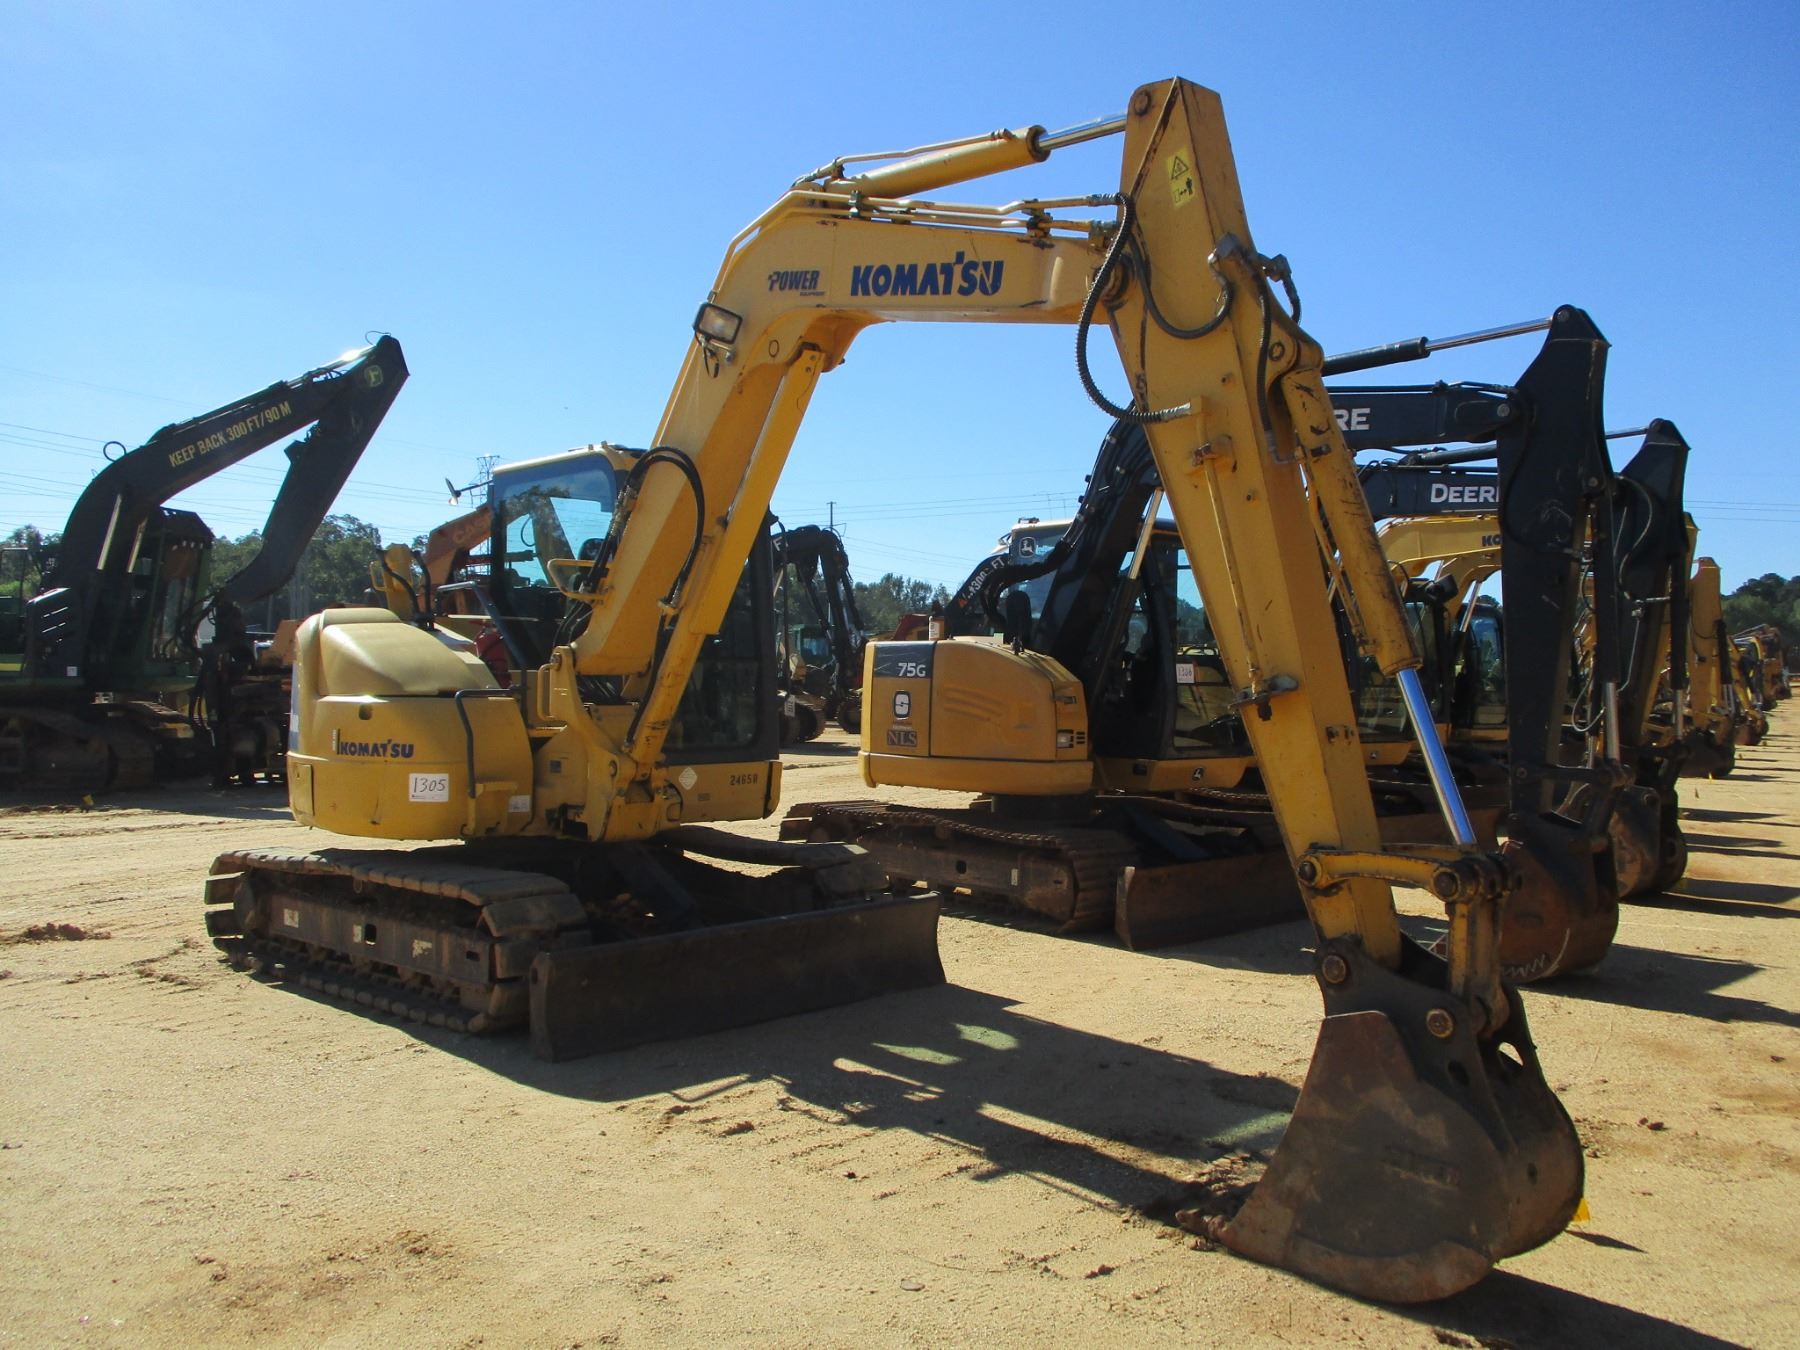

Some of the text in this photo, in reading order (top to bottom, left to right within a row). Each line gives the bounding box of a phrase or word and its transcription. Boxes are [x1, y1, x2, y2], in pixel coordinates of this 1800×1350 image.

[768, 270, 820, 291] POWER
[168, 445, 196, 468] KEEP
[197, 431, 227, 454] BACK
[226, 420, 247, 441] 300
[898, 662, 926, 677] 75G
[413, 777, 447, 793] 1305
